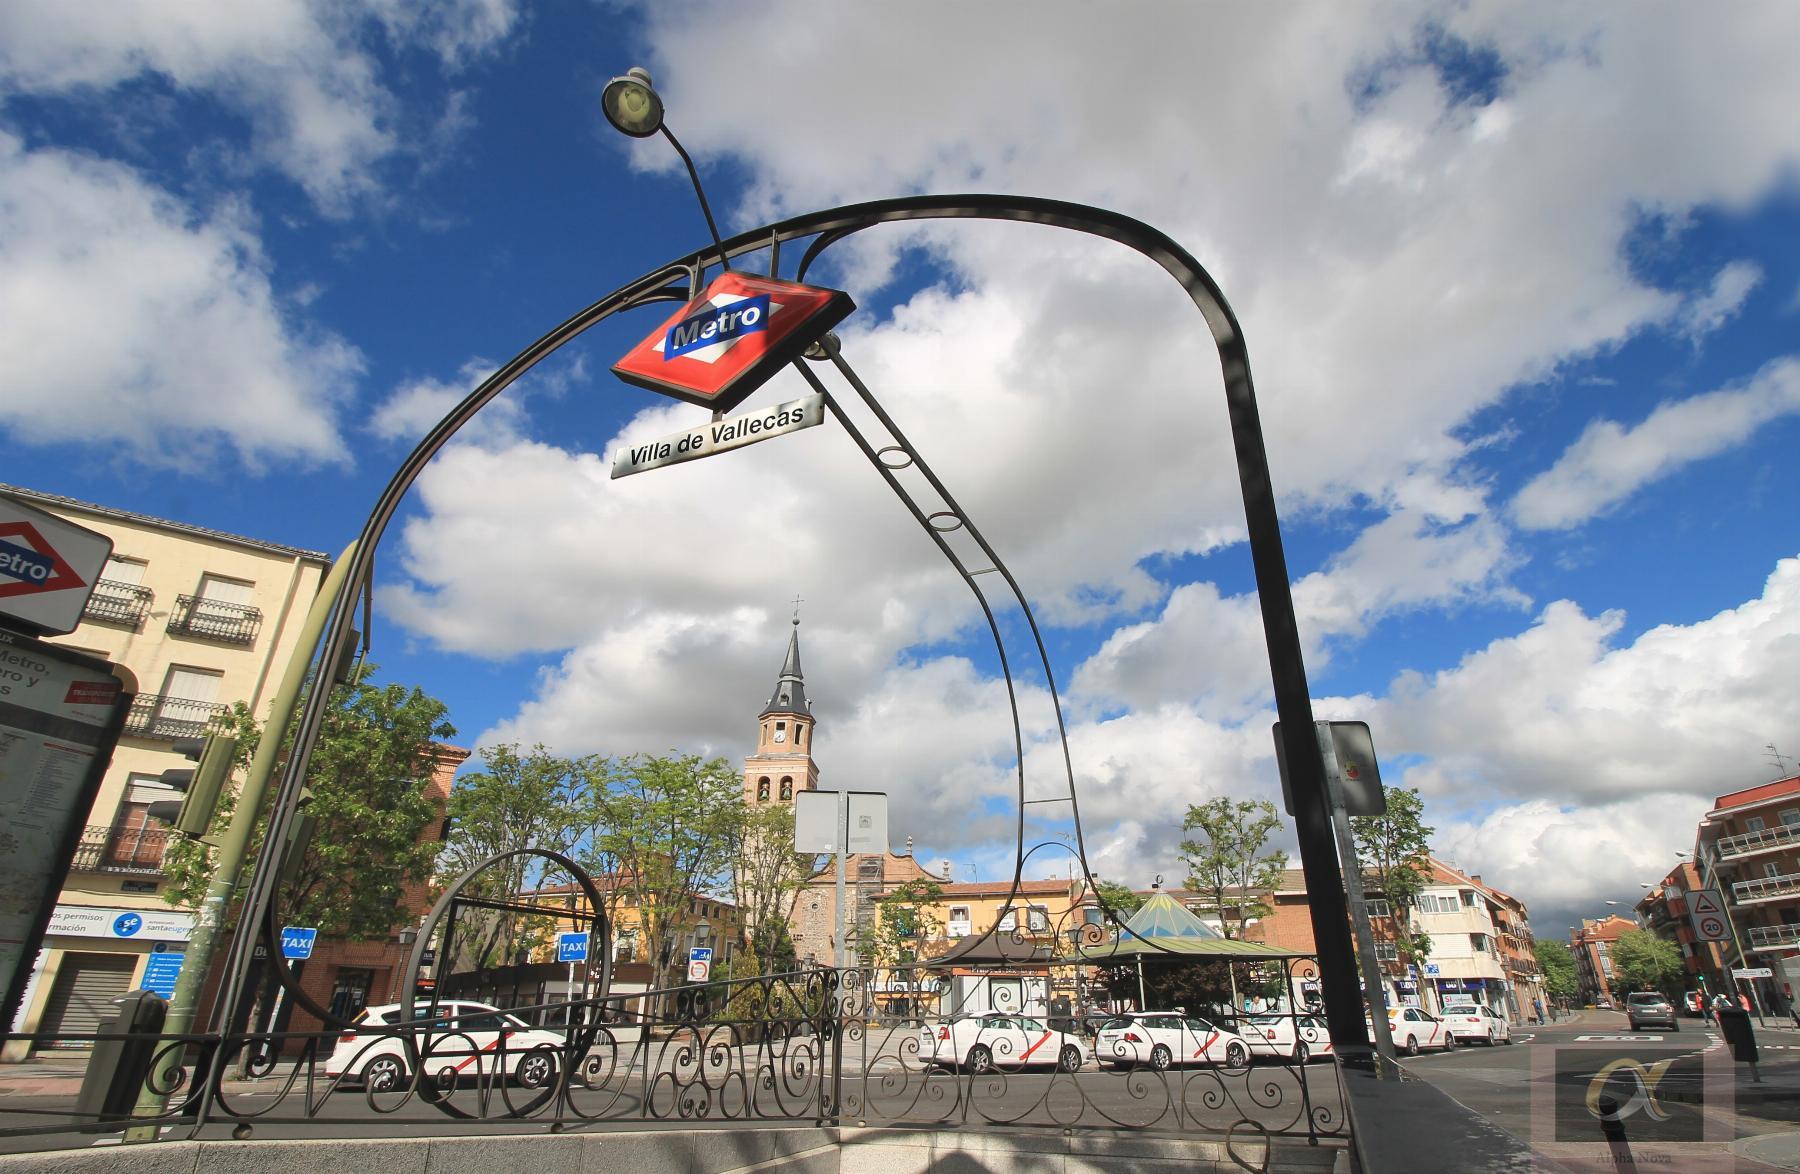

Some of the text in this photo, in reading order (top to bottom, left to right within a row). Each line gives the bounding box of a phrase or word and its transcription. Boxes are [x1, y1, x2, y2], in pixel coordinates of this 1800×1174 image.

[673, 306, 761, 350] Metro
[630, 407, 804, 466] Villa de Vallecas
[26, 675, 39, 688] y
[63, 912, 104, 921] permisos
[1705, 923, 1720, 932] 20
[282, 937, 312, 949] TAXI
[561, 942, 587, 952] TAXI
